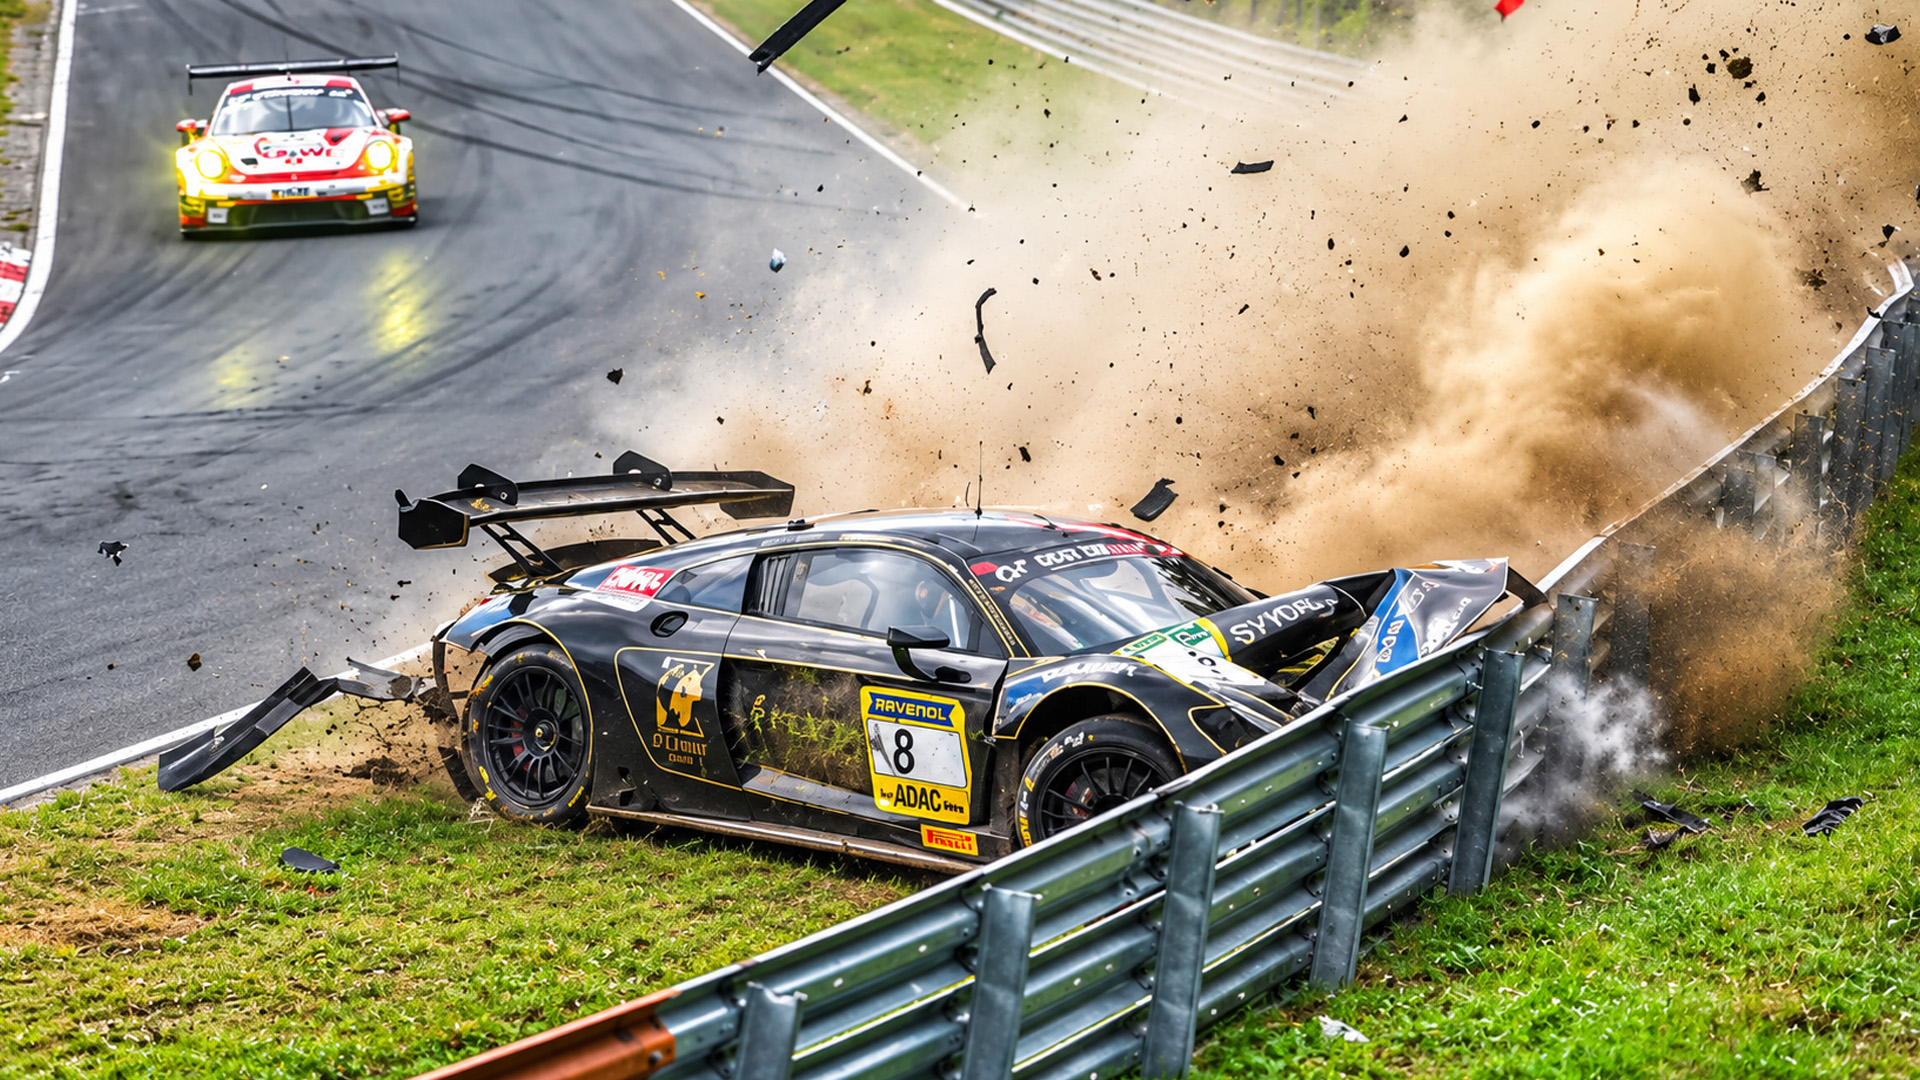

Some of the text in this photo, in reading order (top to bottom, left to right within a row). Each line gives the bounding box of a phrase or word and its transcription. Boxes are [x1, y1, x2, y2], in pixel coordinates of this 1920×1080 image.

[875, 698, 947, 720] RAVENOL
[893, 728, 915, 775] 8
[894, 783, 942, 812] ADAC
